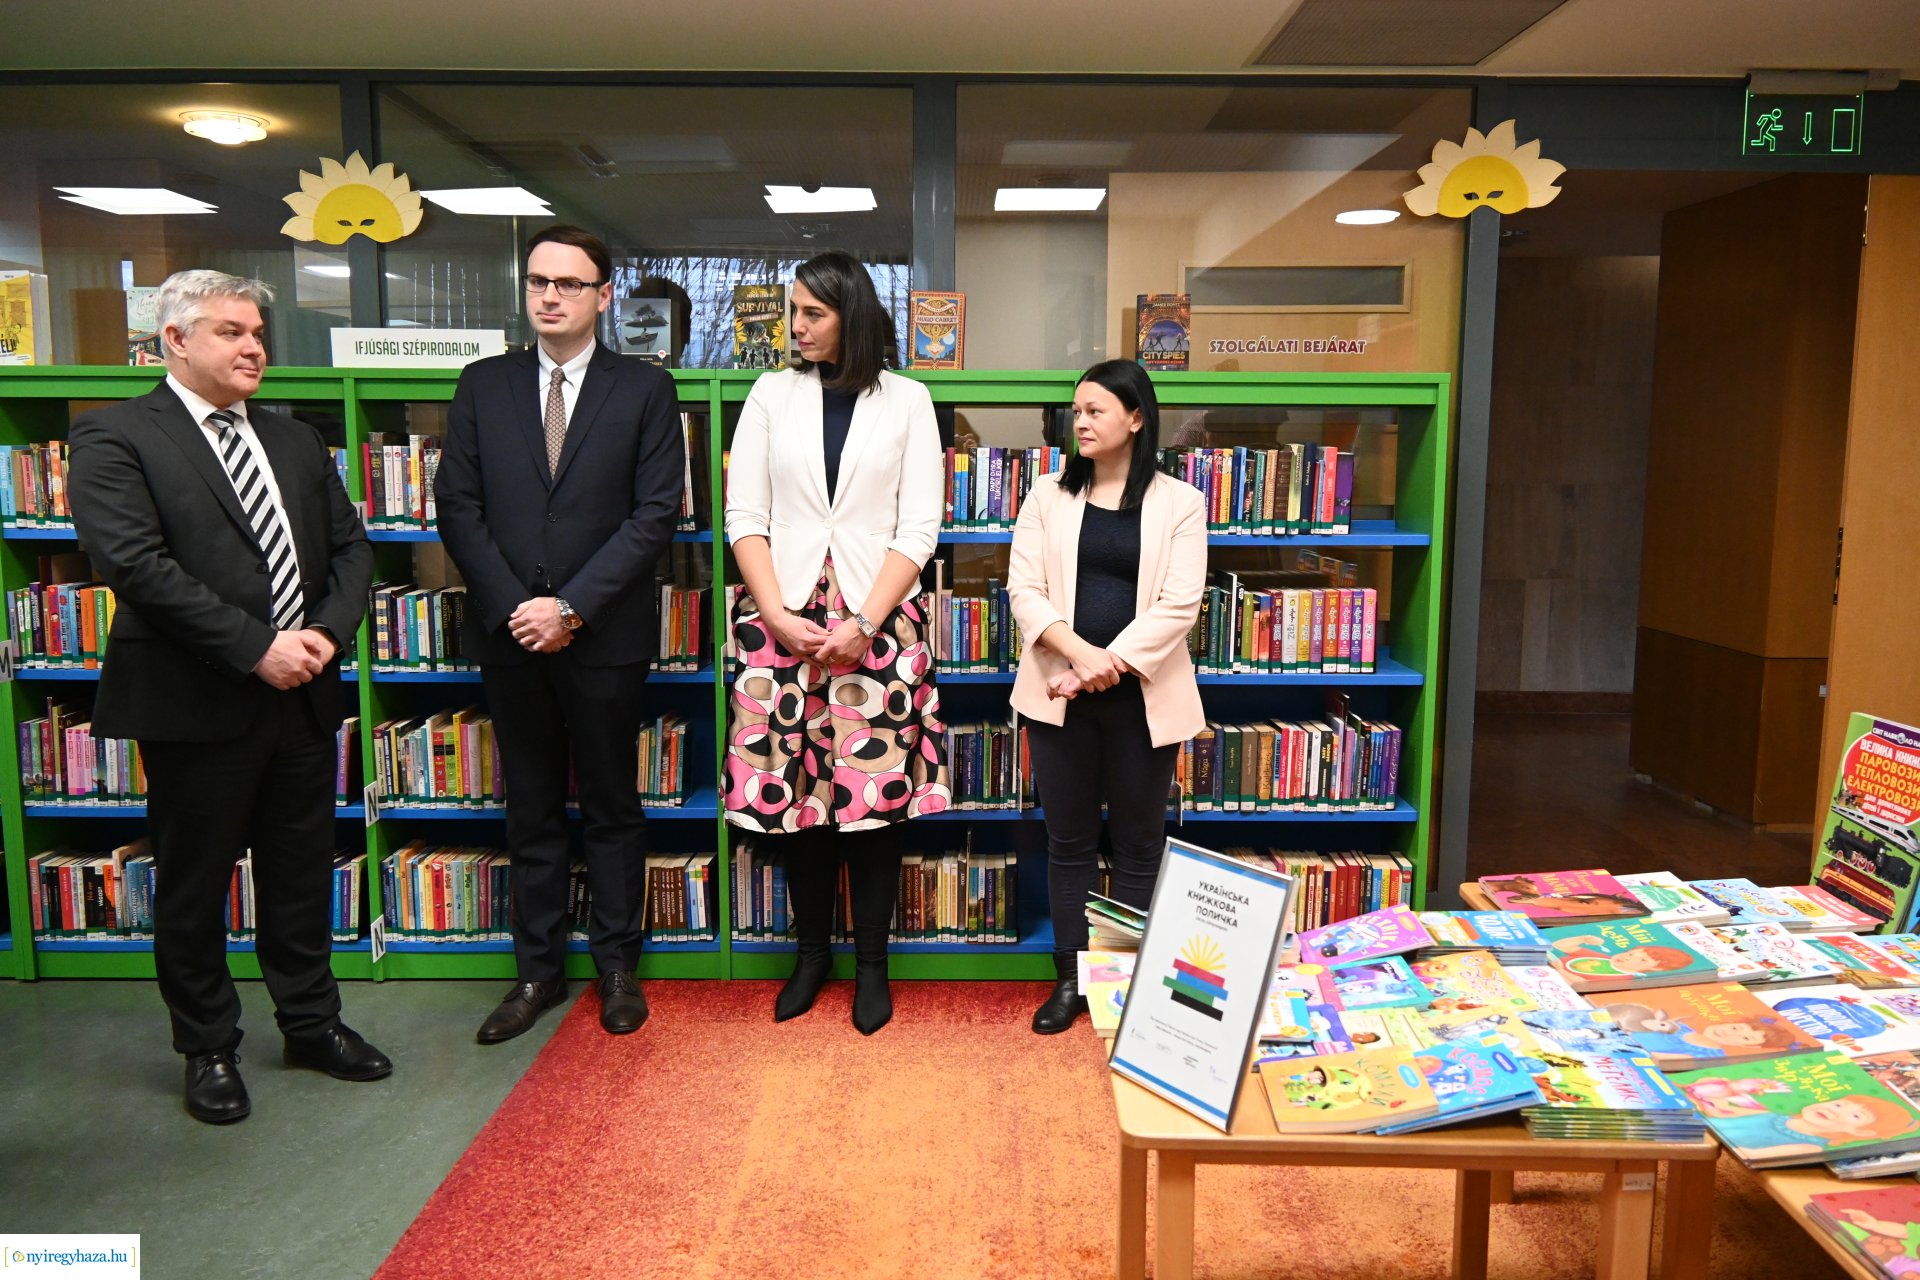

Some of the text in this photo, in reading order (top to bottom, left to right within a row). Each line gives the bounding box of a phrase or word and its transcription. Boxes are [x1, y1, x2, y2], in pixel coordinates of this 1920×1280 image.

[736, 301, 784, 313] SURVIVAL
[355, 338, 480, 357] IFJÚSÁGI SZÉPIRODALOM
[1142, 351, 1186, 360] CITY SPIES
[1208, 336, 1367, 354] SZOLGÁLATI BEJÁRAT
[1860, 738, 1893, 760] ВЕЛИКА
[367, 788, 378, 823] N
[1187, 889, 1236, 914] КНИЖКОВА
[1198, 880, 1249, 906] УКРАЇНСЬКА
[1195, 905, 1238, 928] ПОЛИЧКА
[374, 923, 385, 958] N
[1702, 993, 1743, 1016] Мої
[1446, 1047, 1496, 1096] КОСМОС
[1802, 1062, 1852, 1093] Мої
